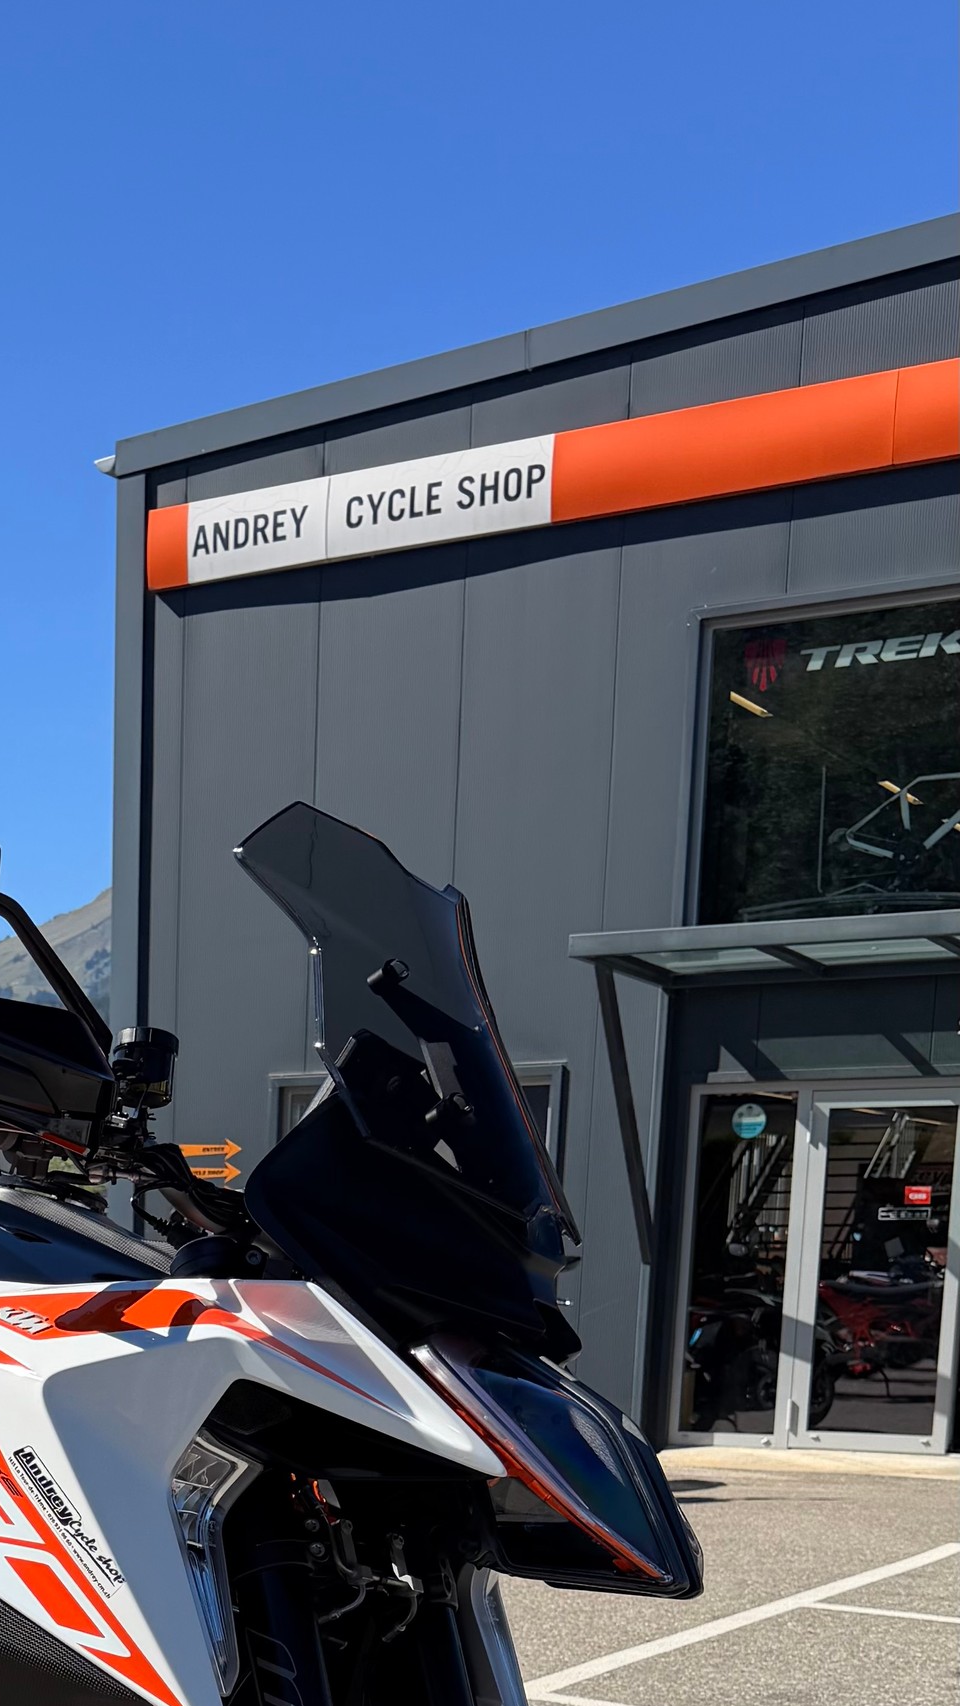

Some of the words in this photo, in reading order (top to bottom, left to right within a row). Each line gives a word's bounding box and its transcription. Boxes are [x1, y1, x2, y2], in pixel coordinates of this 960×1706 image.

[192, 505, 308, 557] ANDREY
[345, 481, 443, 529] CYCLE
[456, 464, 546, 509] SHOP
[800, 629, 960, 672] TREK
[20, 1449, 73, 1521] Andrey
[69, 1519, 99, 1553] Cycle
[96, 1554, 125, 1585] shop
